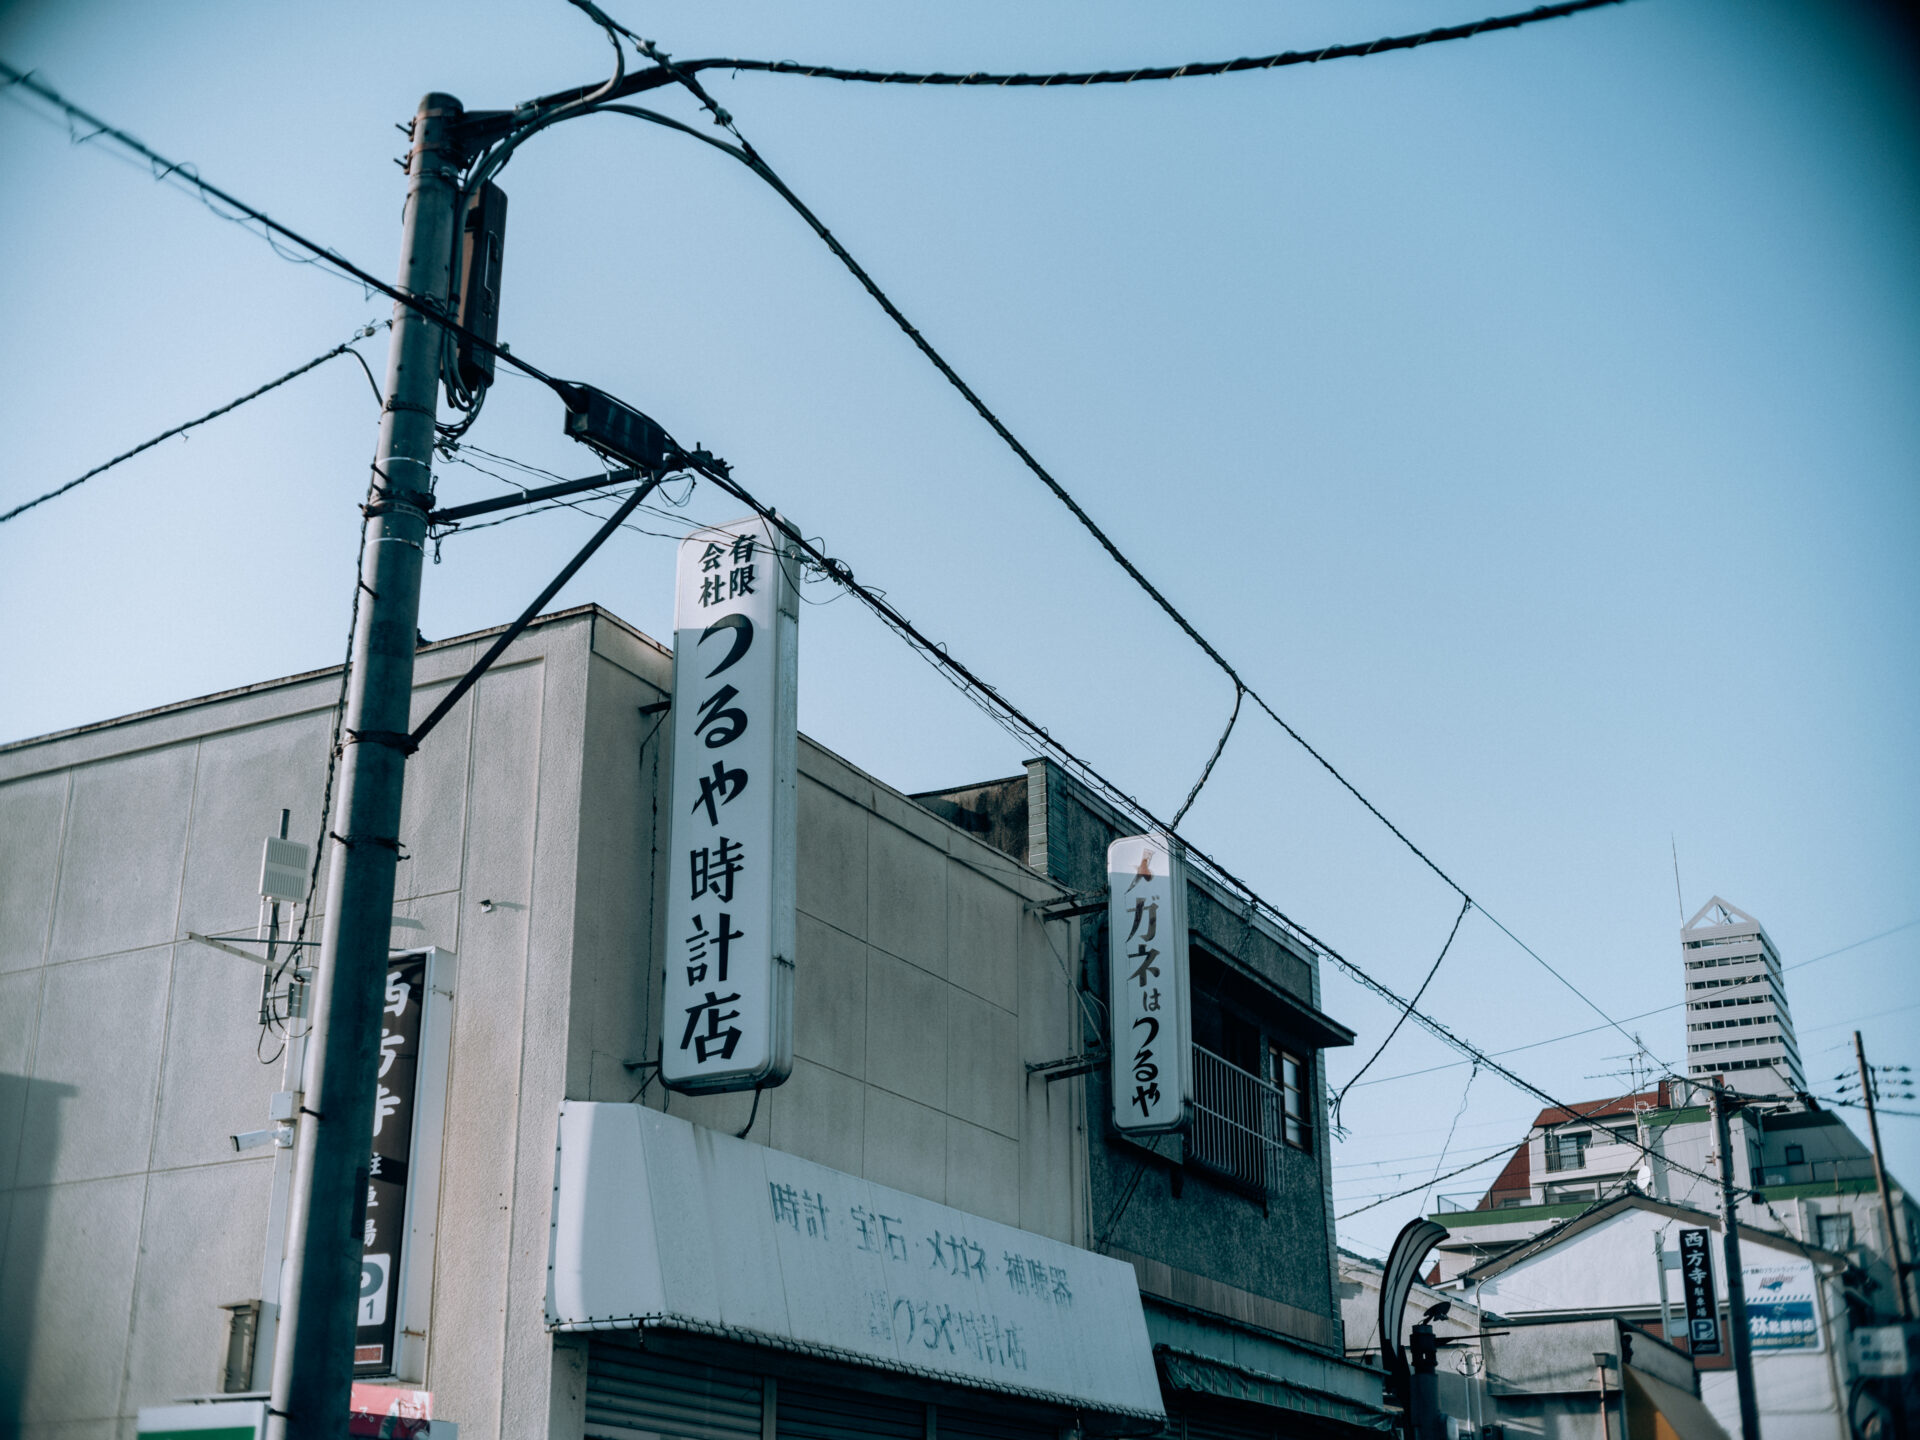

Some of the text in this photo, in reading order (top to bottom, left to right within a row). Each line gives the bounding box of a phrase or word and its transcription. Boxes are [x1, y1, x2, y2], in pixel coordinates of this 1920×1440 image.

[680, 612, 754, 1065] つるや時計店
[1693, 1321, 1713, 1339] P
